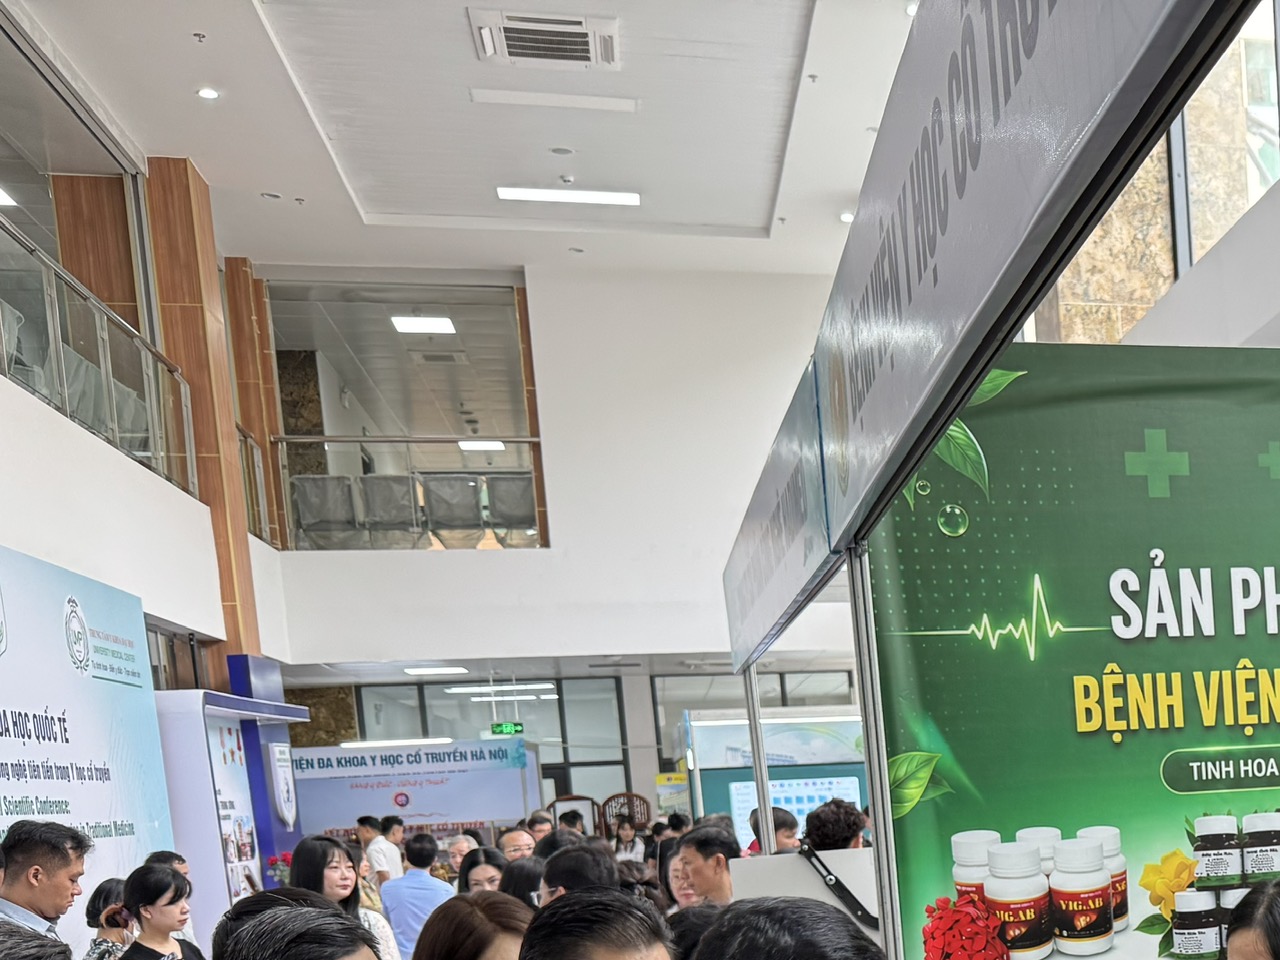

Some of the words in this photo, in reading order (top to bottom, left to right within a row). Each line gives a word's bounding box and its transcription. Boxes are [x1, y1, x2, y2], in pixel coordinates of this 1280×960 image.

[897, 181, 912, 306] Y
[909, 97, 949, 288] HỌC
[1109, 548, 1216, 640] SẢN
[11, 710, 31, 746] HỌC
[32, 705, 58, 744] QUỐC
[57, 709, 70, 744] TẾ
[1073, 662, 1185, 744] BỆNH
[318, 758, 334, 770] ĐA
[336, 754, 368, 768] KHOA
[370, 754, 380, 767] Y
[380, 752, 404, 768] HỌC
[470, 746, 488, 762] HÀ
[489, 746, 509, 762] NỘI
[1189, 760, 1234, 781] TINH
[1240, 758, 1280, 779] HOA
